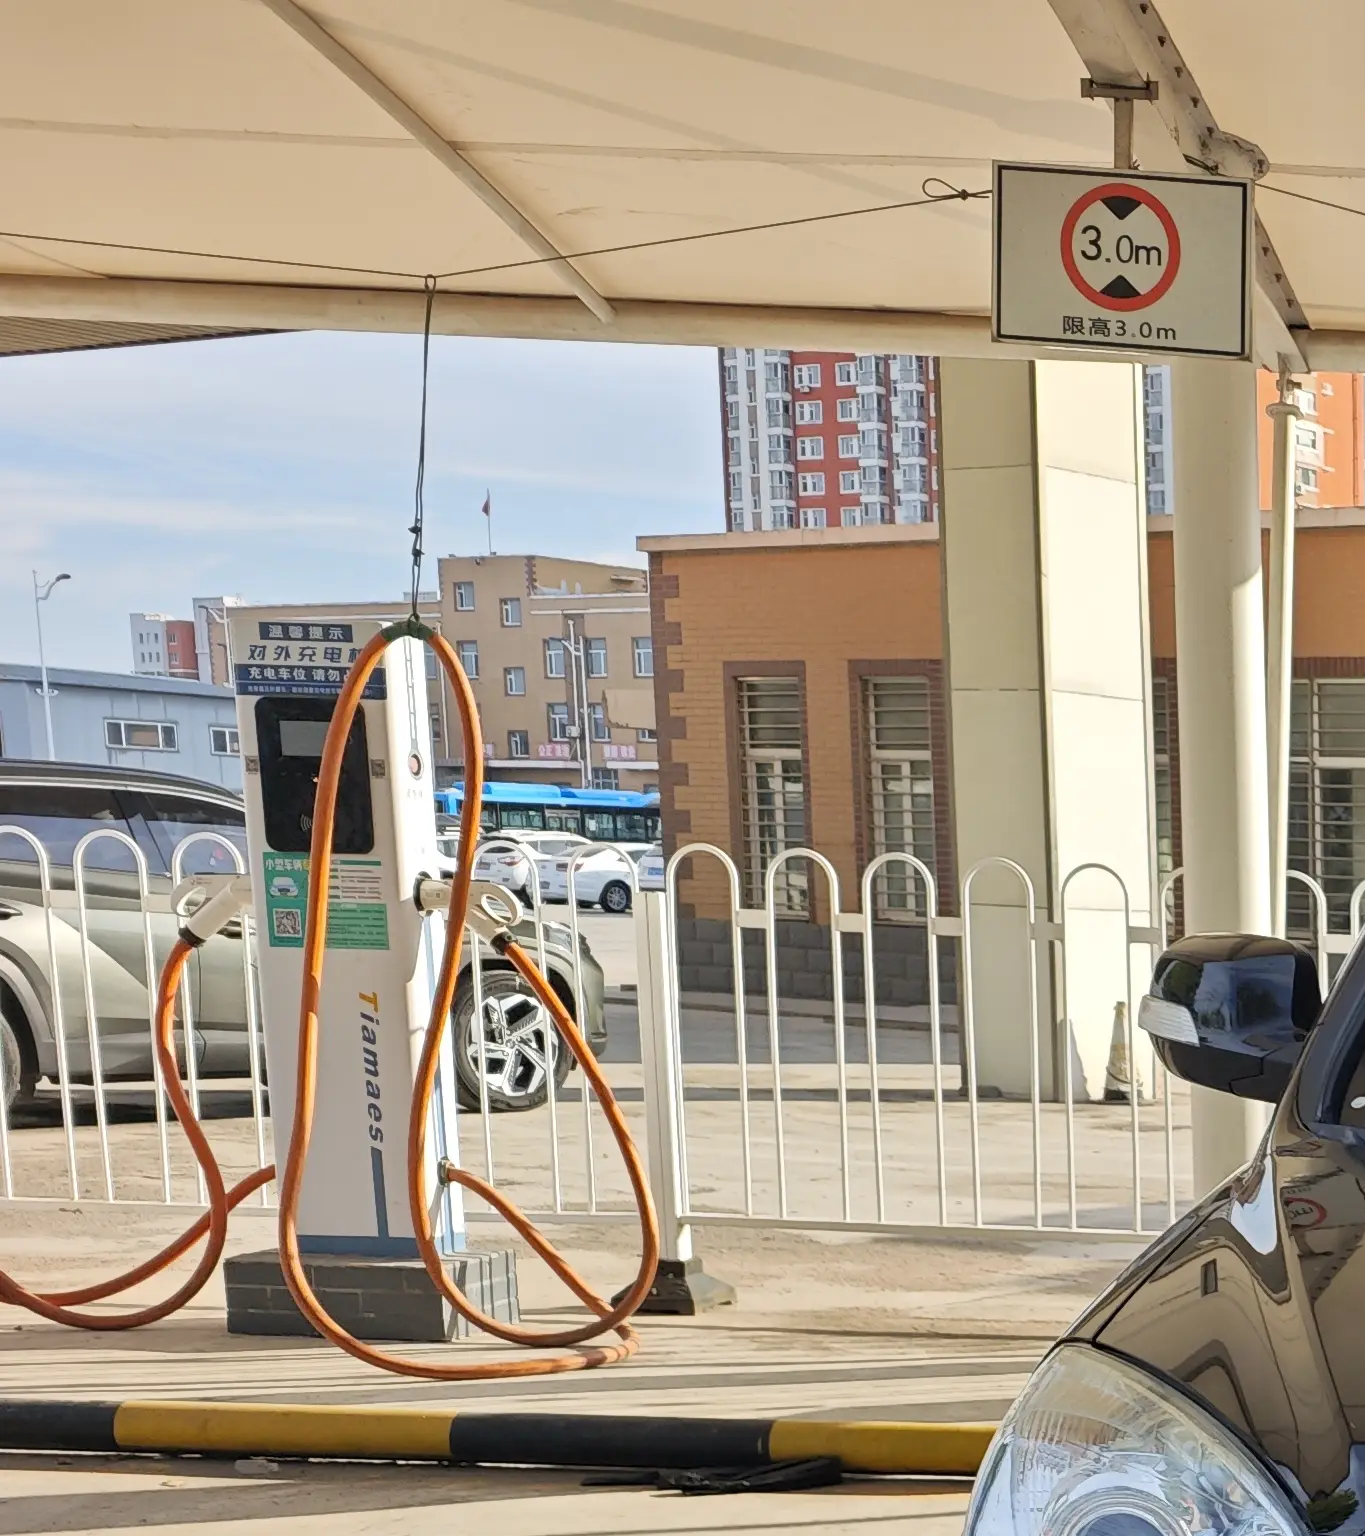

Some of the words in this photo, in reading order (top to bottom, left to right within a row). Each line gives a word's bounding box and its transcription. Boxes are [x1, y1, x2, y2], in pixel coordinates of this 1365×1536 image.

[1080, 224, 1163, 266] 3.0m
[268, 624, 344, 641] 温馨提示
[247, 666, 307, 681] 充电车位
[358, 991, 385, 1147] Tiamaes
